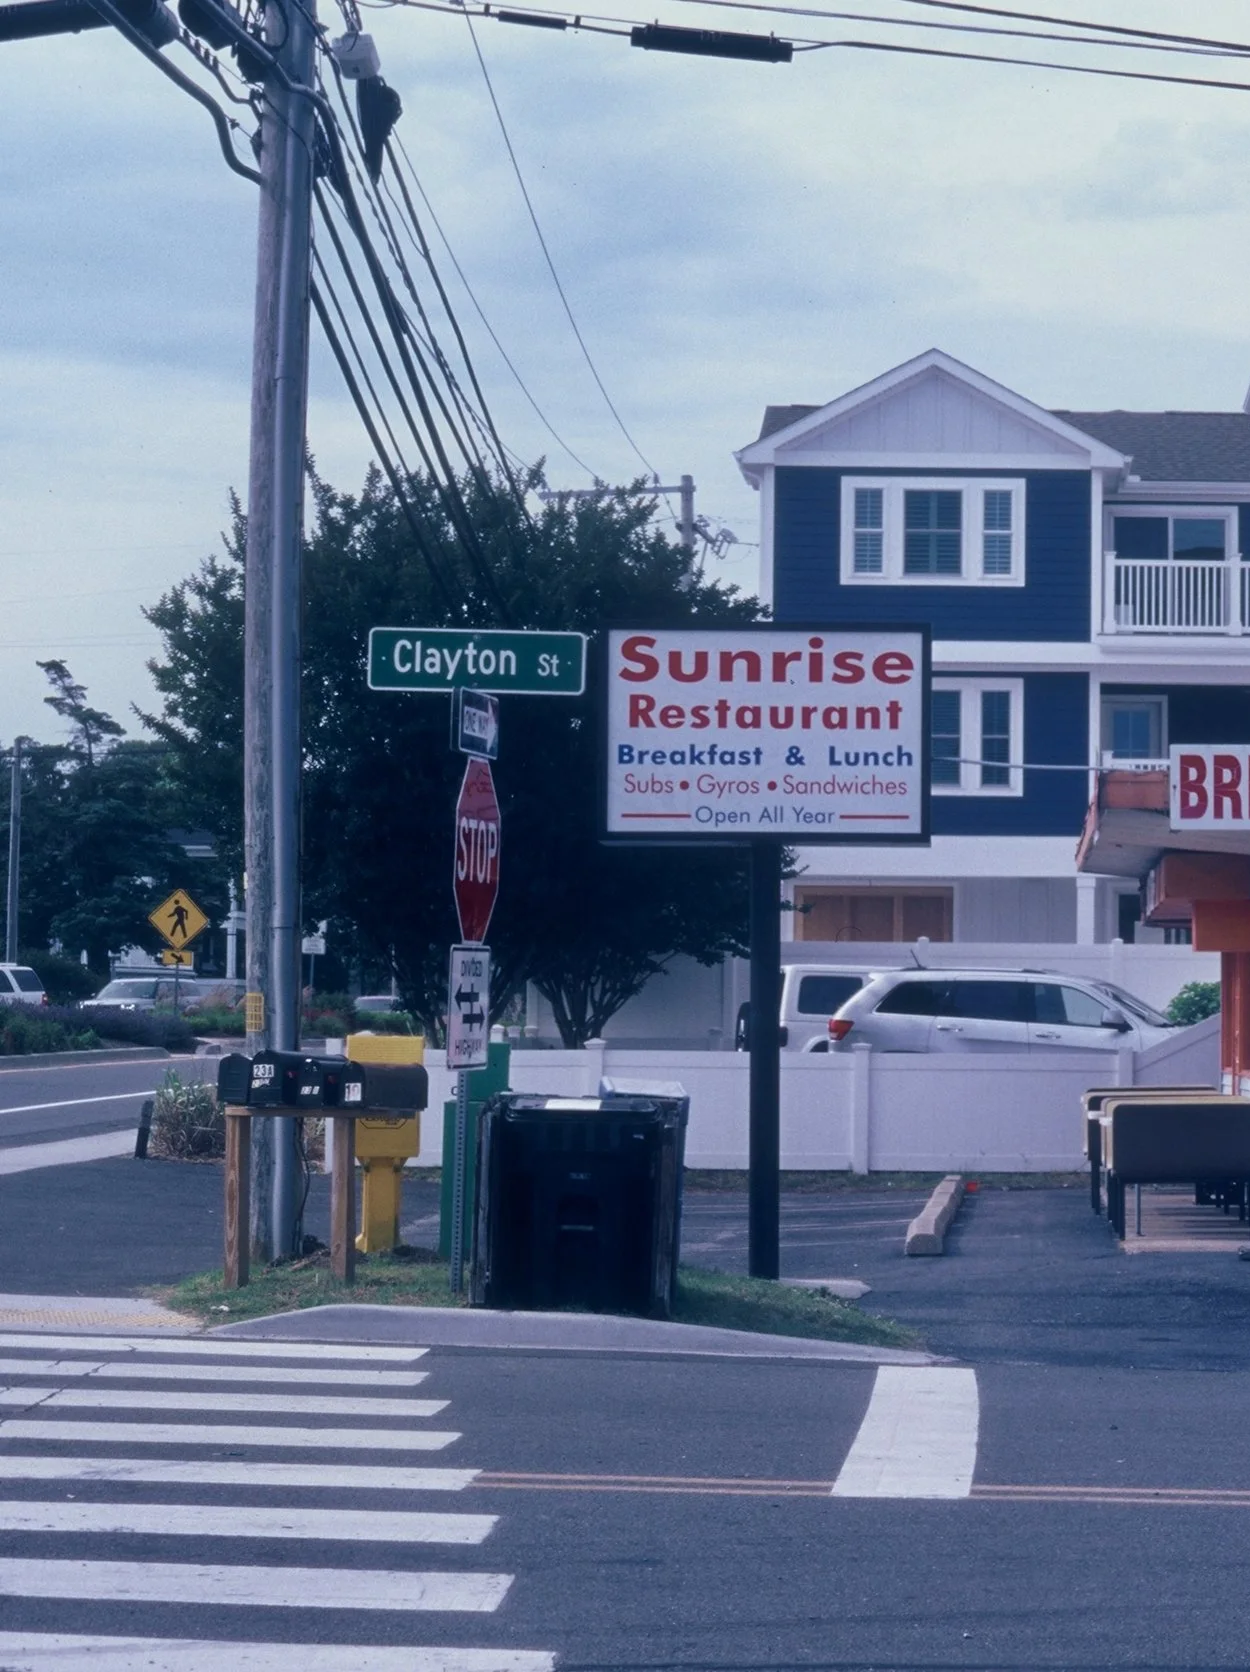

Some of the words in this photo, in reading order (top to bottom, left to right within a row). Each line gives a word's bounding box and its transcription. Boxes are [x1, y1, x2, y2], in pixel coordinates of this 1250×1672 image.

[393, 639, 516, 680] Clayton
[537, 653, 559, 677] St
[618, 636, 914, 684] Sunrise
[629, 694, 902, 730] Restaurant
[618, 744, 763, 766] Breakfast
[785, 745, 806, 766] &
[828, 745, 914, 767] Lunch
[624, 773, 674, 794] Subs
[697, 773, 760, 799] Gyros
[783, 774, 908, 796] Sandwiches
[695, 806, 750, 827] Open
[758, 806, 784, 824] All
[793, 806, 835, 824] Year
[457, 816, 498, 884] STOP
[461, 959, 482, 977] DIVIDED
[454, 1039, 482, 1056] HIGHWAY
